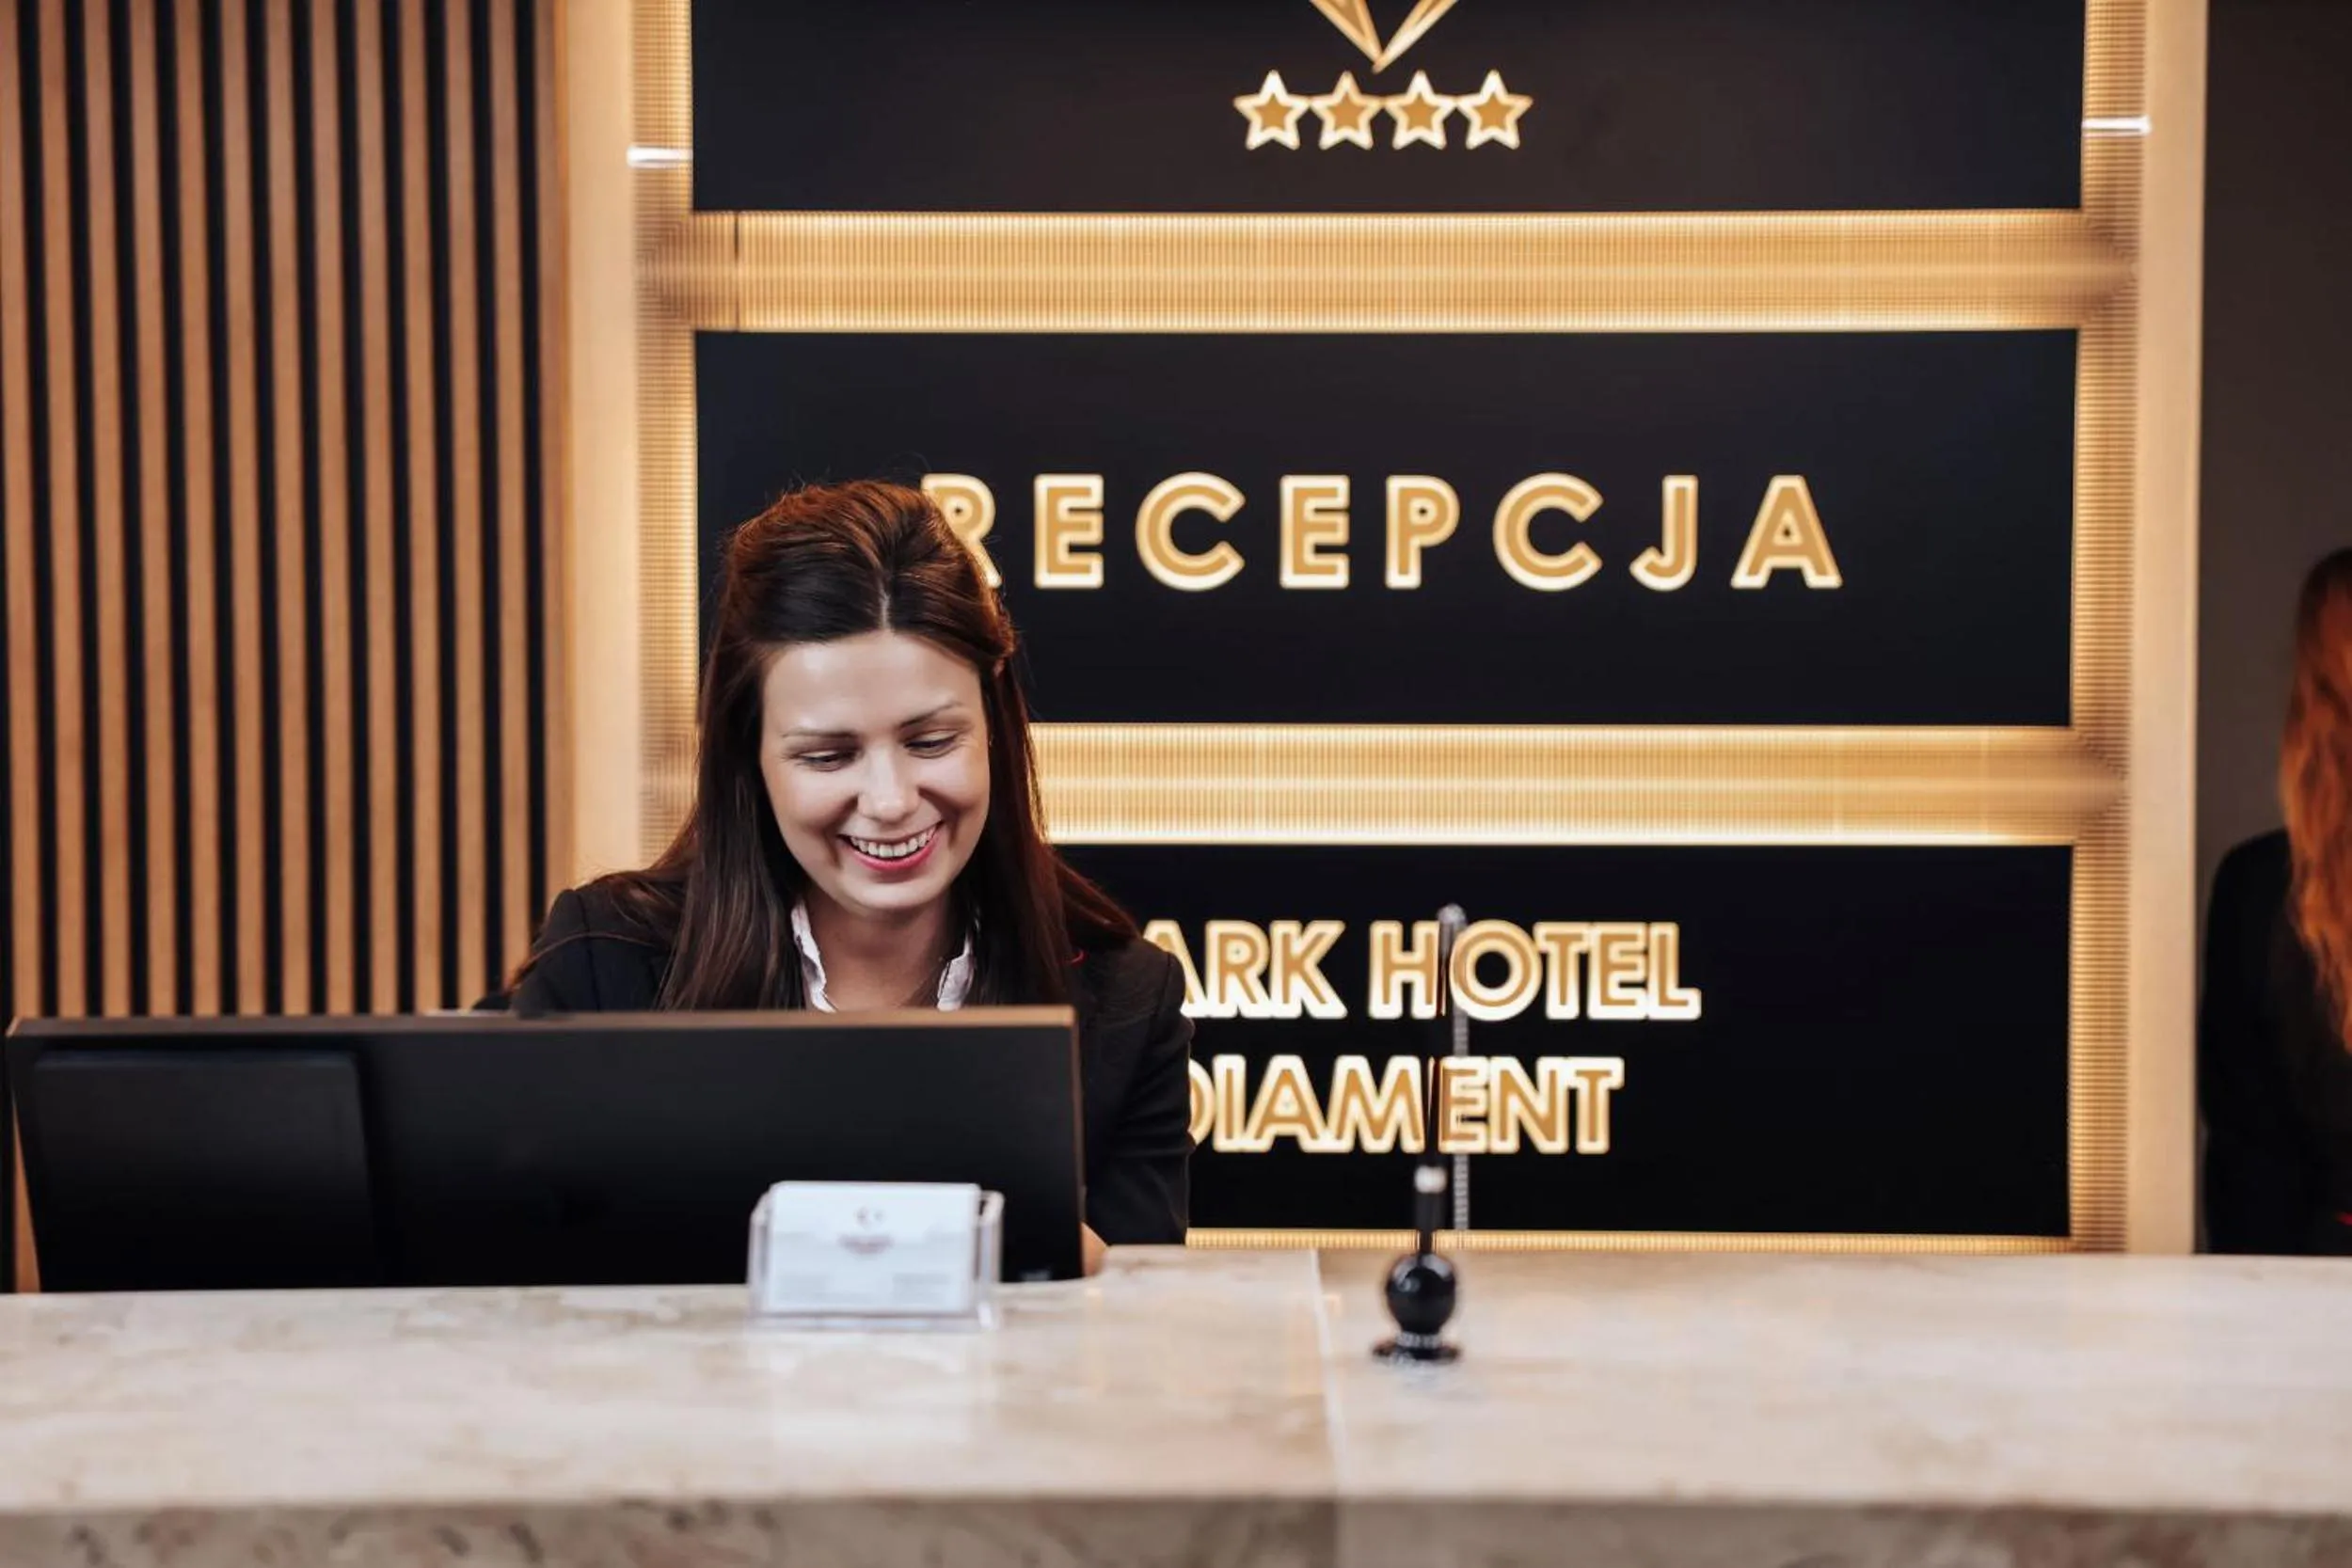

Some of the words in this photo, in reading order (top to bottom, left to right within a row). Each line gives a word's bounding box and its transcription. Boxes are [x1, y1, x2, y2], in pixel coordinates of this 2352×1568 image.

[921, 472, 1843, 592] RECEPCJA
[1142, 919, 1348, 1019] ARK
[1369, 919, 1702, 1021] HOTEL
